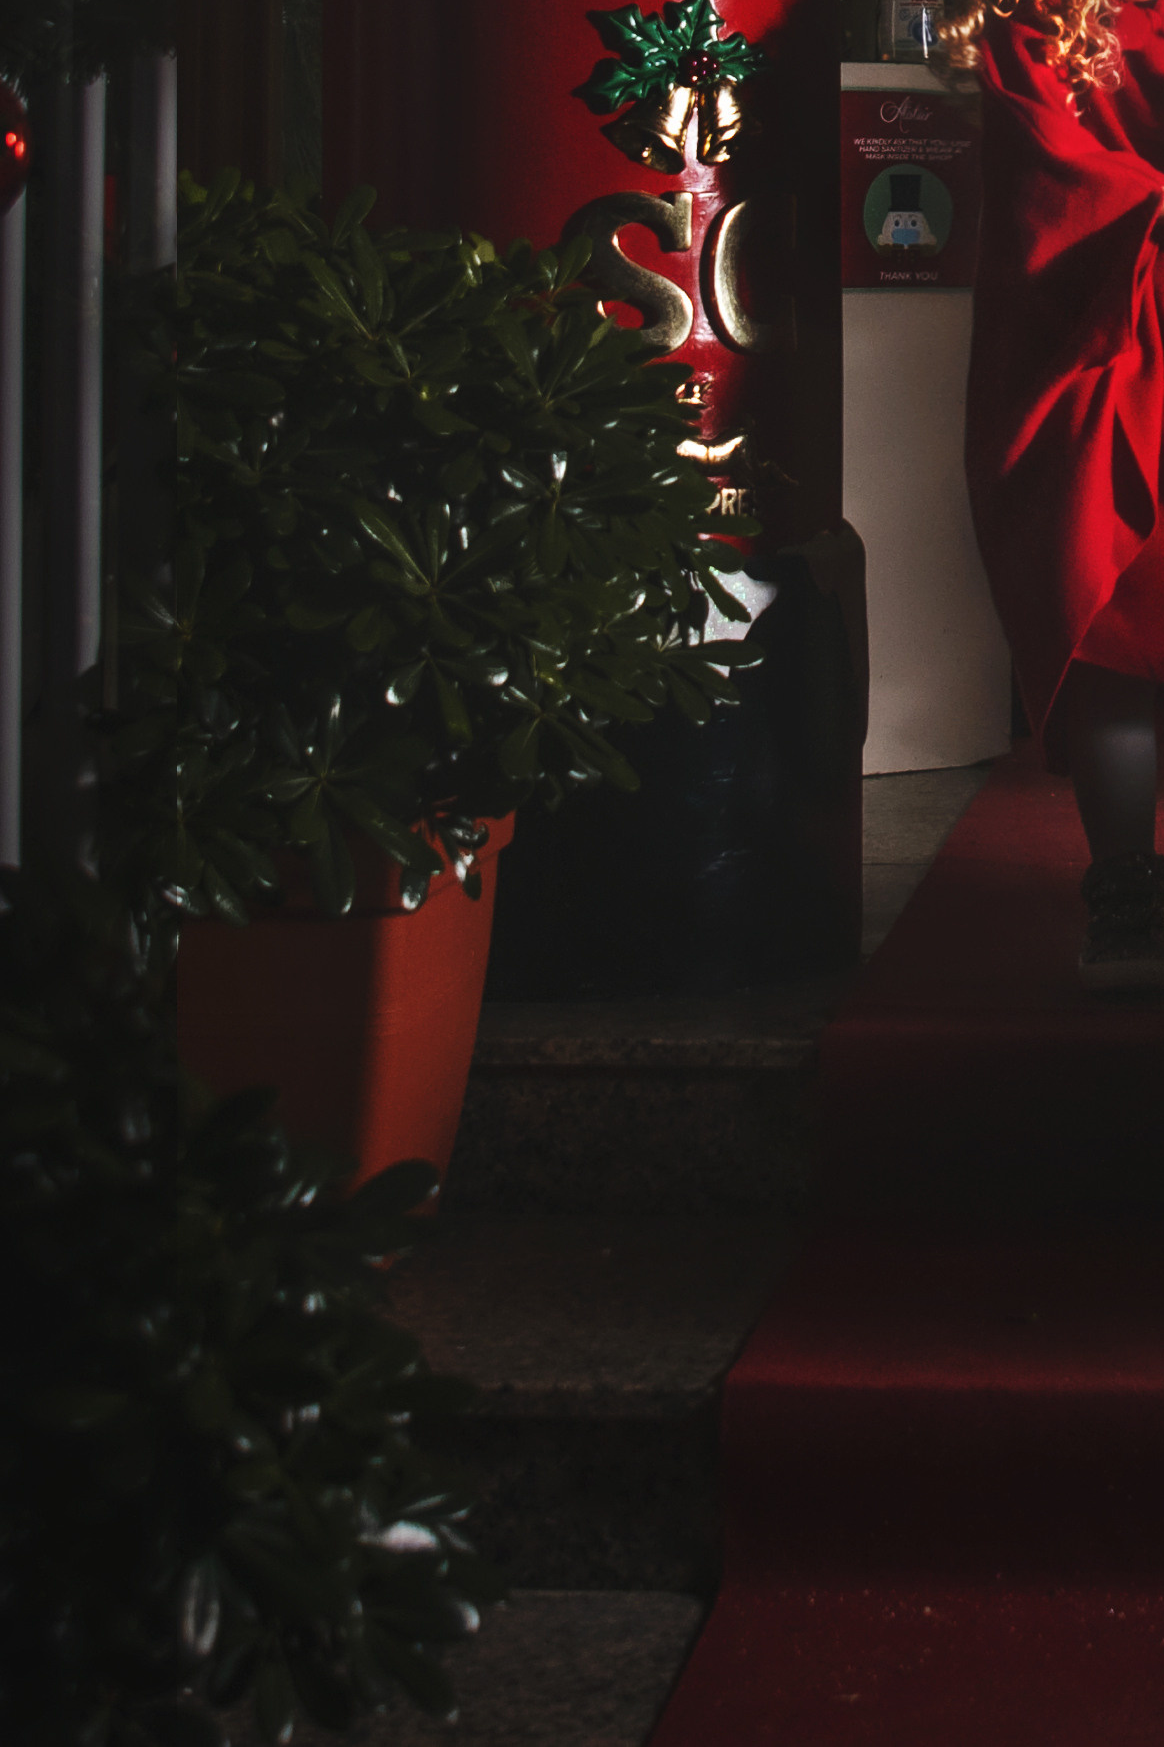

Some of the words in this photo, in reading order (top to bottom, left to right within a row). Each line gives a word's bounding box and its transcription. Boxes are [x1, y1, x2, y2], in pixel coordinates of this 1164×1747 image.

[853, 137, 865, 146] WE
[866, 137, 893, 146] KINDLY
[893, 137, 907, 146] ASK
[907, 137, 928, 146] THAT
[858, 145, 880, 154] HAND
[865, 154, 885, 162] MASK
[887, 154, 910, 162] INSIDE
[911, 154, 925, 162] THE
[879, 272, 913, 284] THANK
[914, 272, 938, 284] YOU
